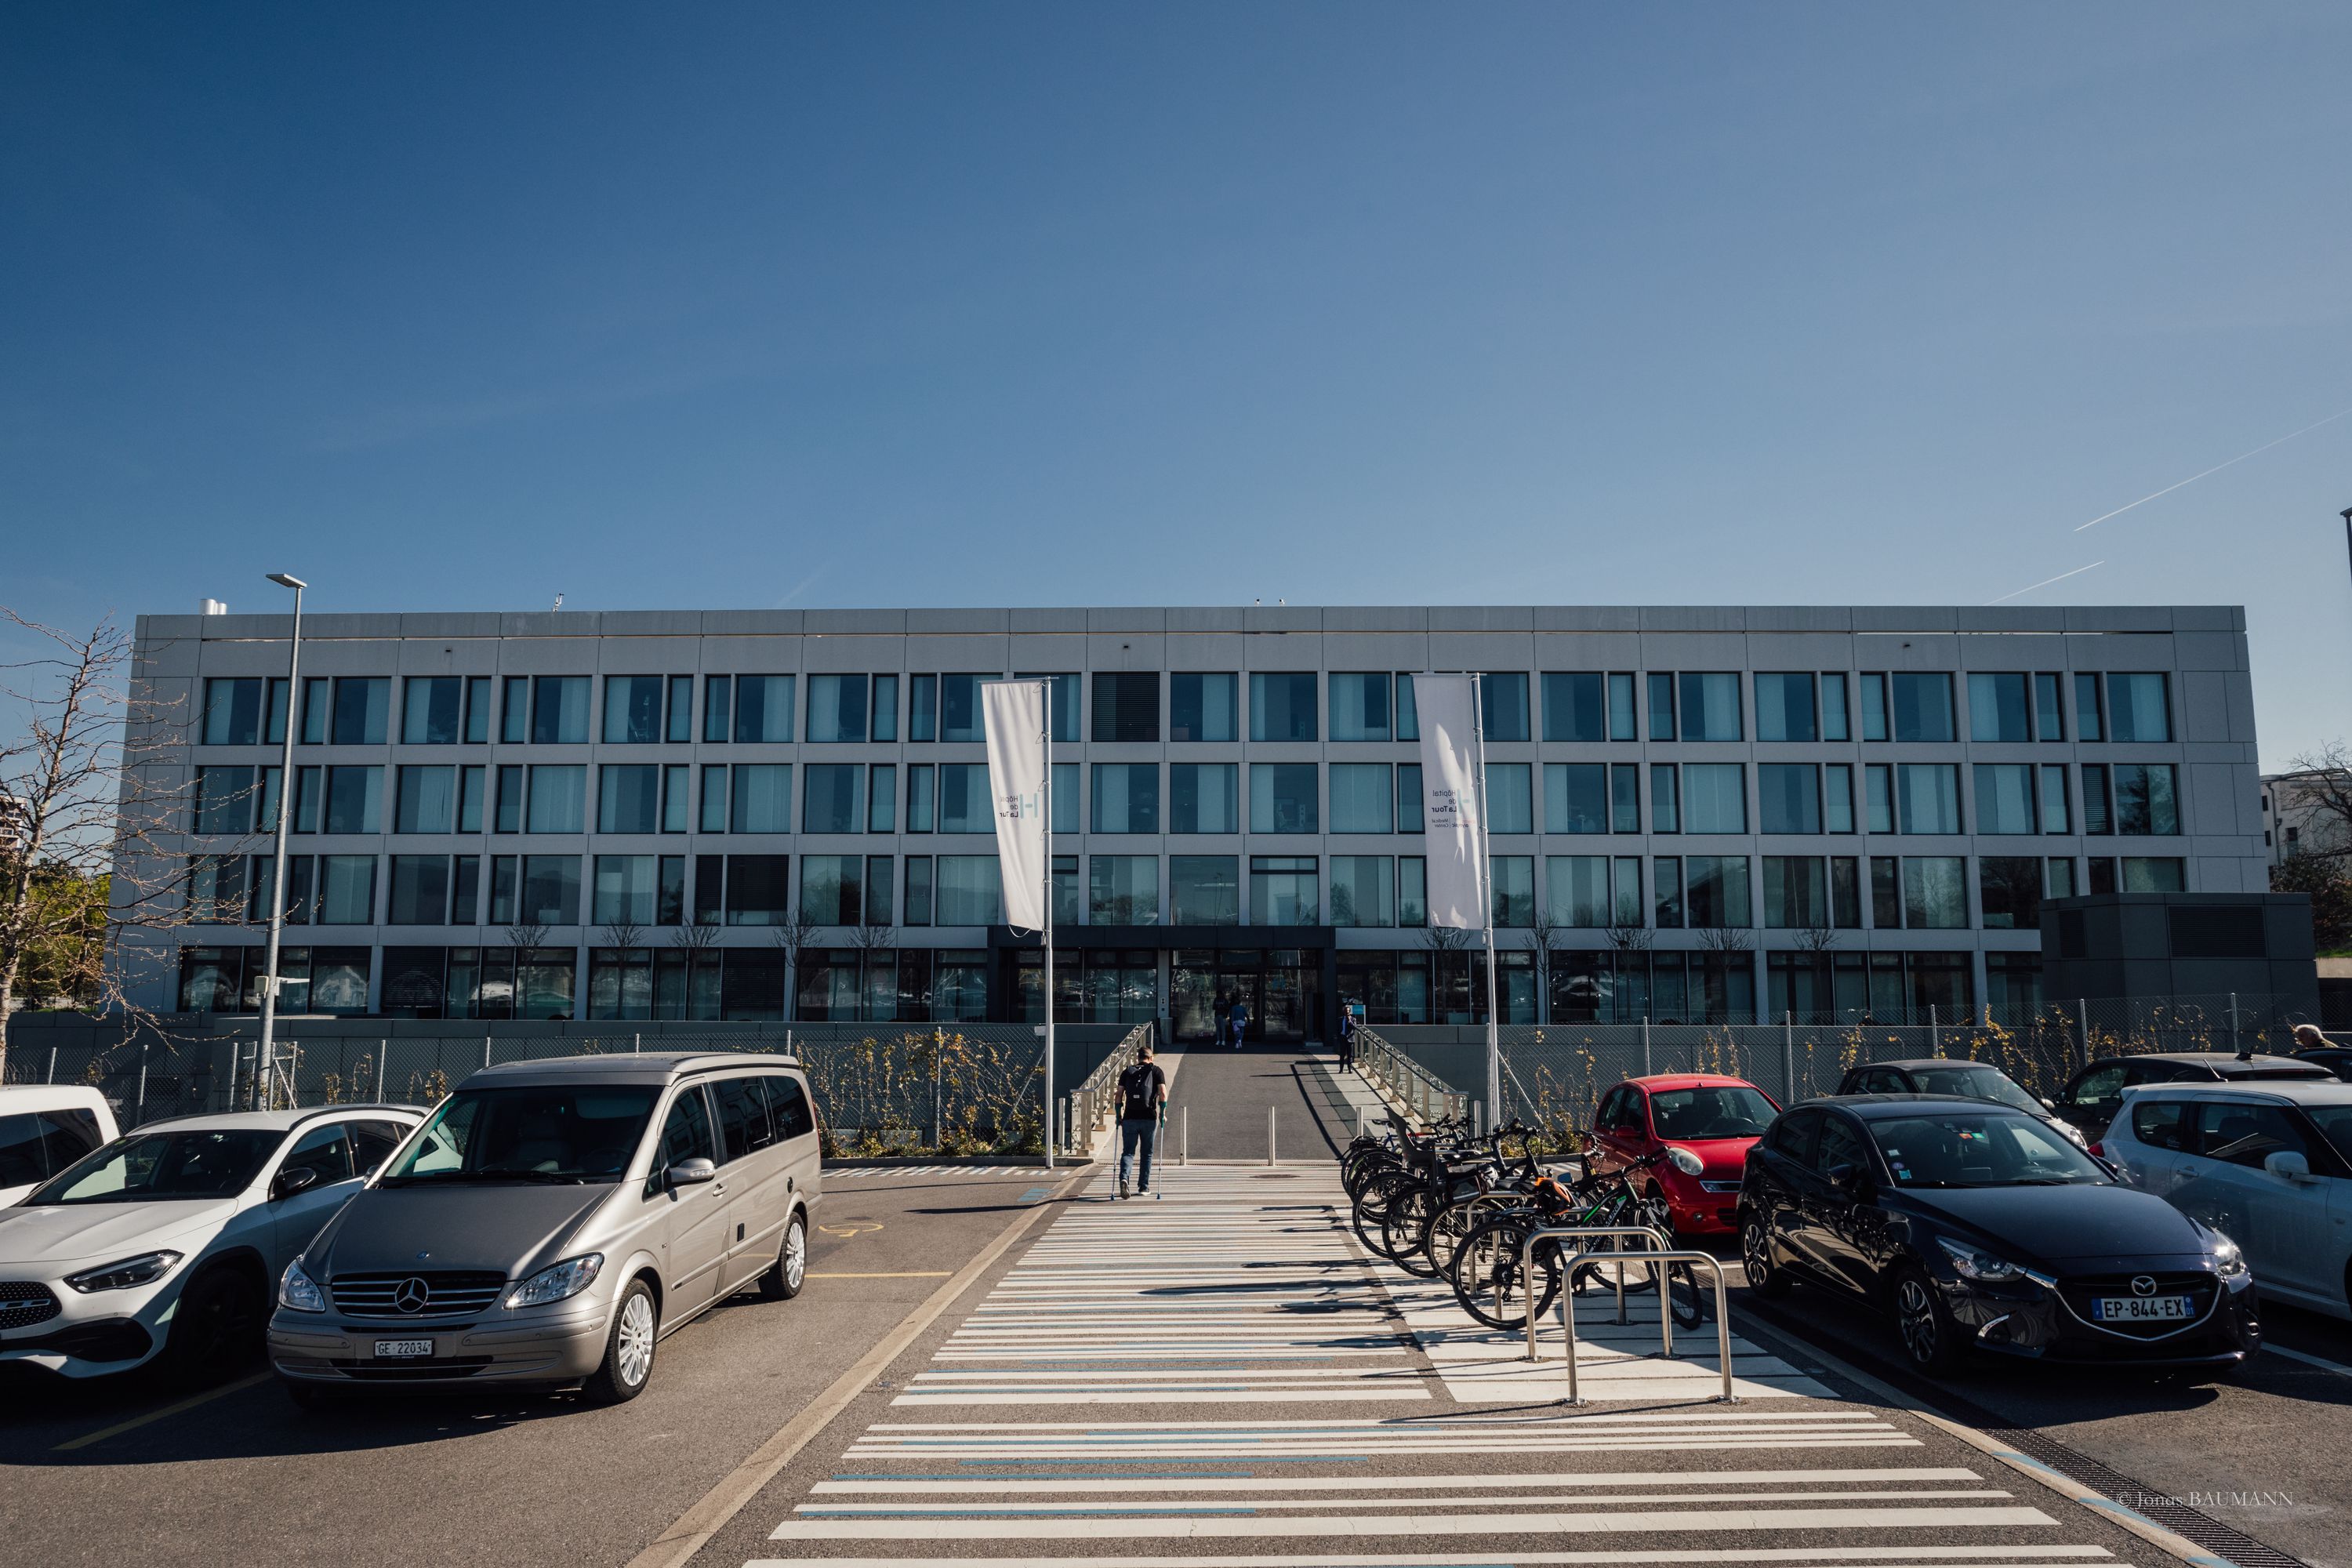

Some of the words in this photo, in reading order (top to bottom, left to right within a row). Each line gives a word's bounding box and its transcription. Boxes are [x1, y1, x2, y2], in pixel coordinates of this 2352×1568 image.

[2103, 1299, 2183, 1317] EP-844-EX
[2186, 1307, 2194, 1316] 01
[378, 1342, 390, 1355] GE
[397, 1342, 428, 1355] 22034
